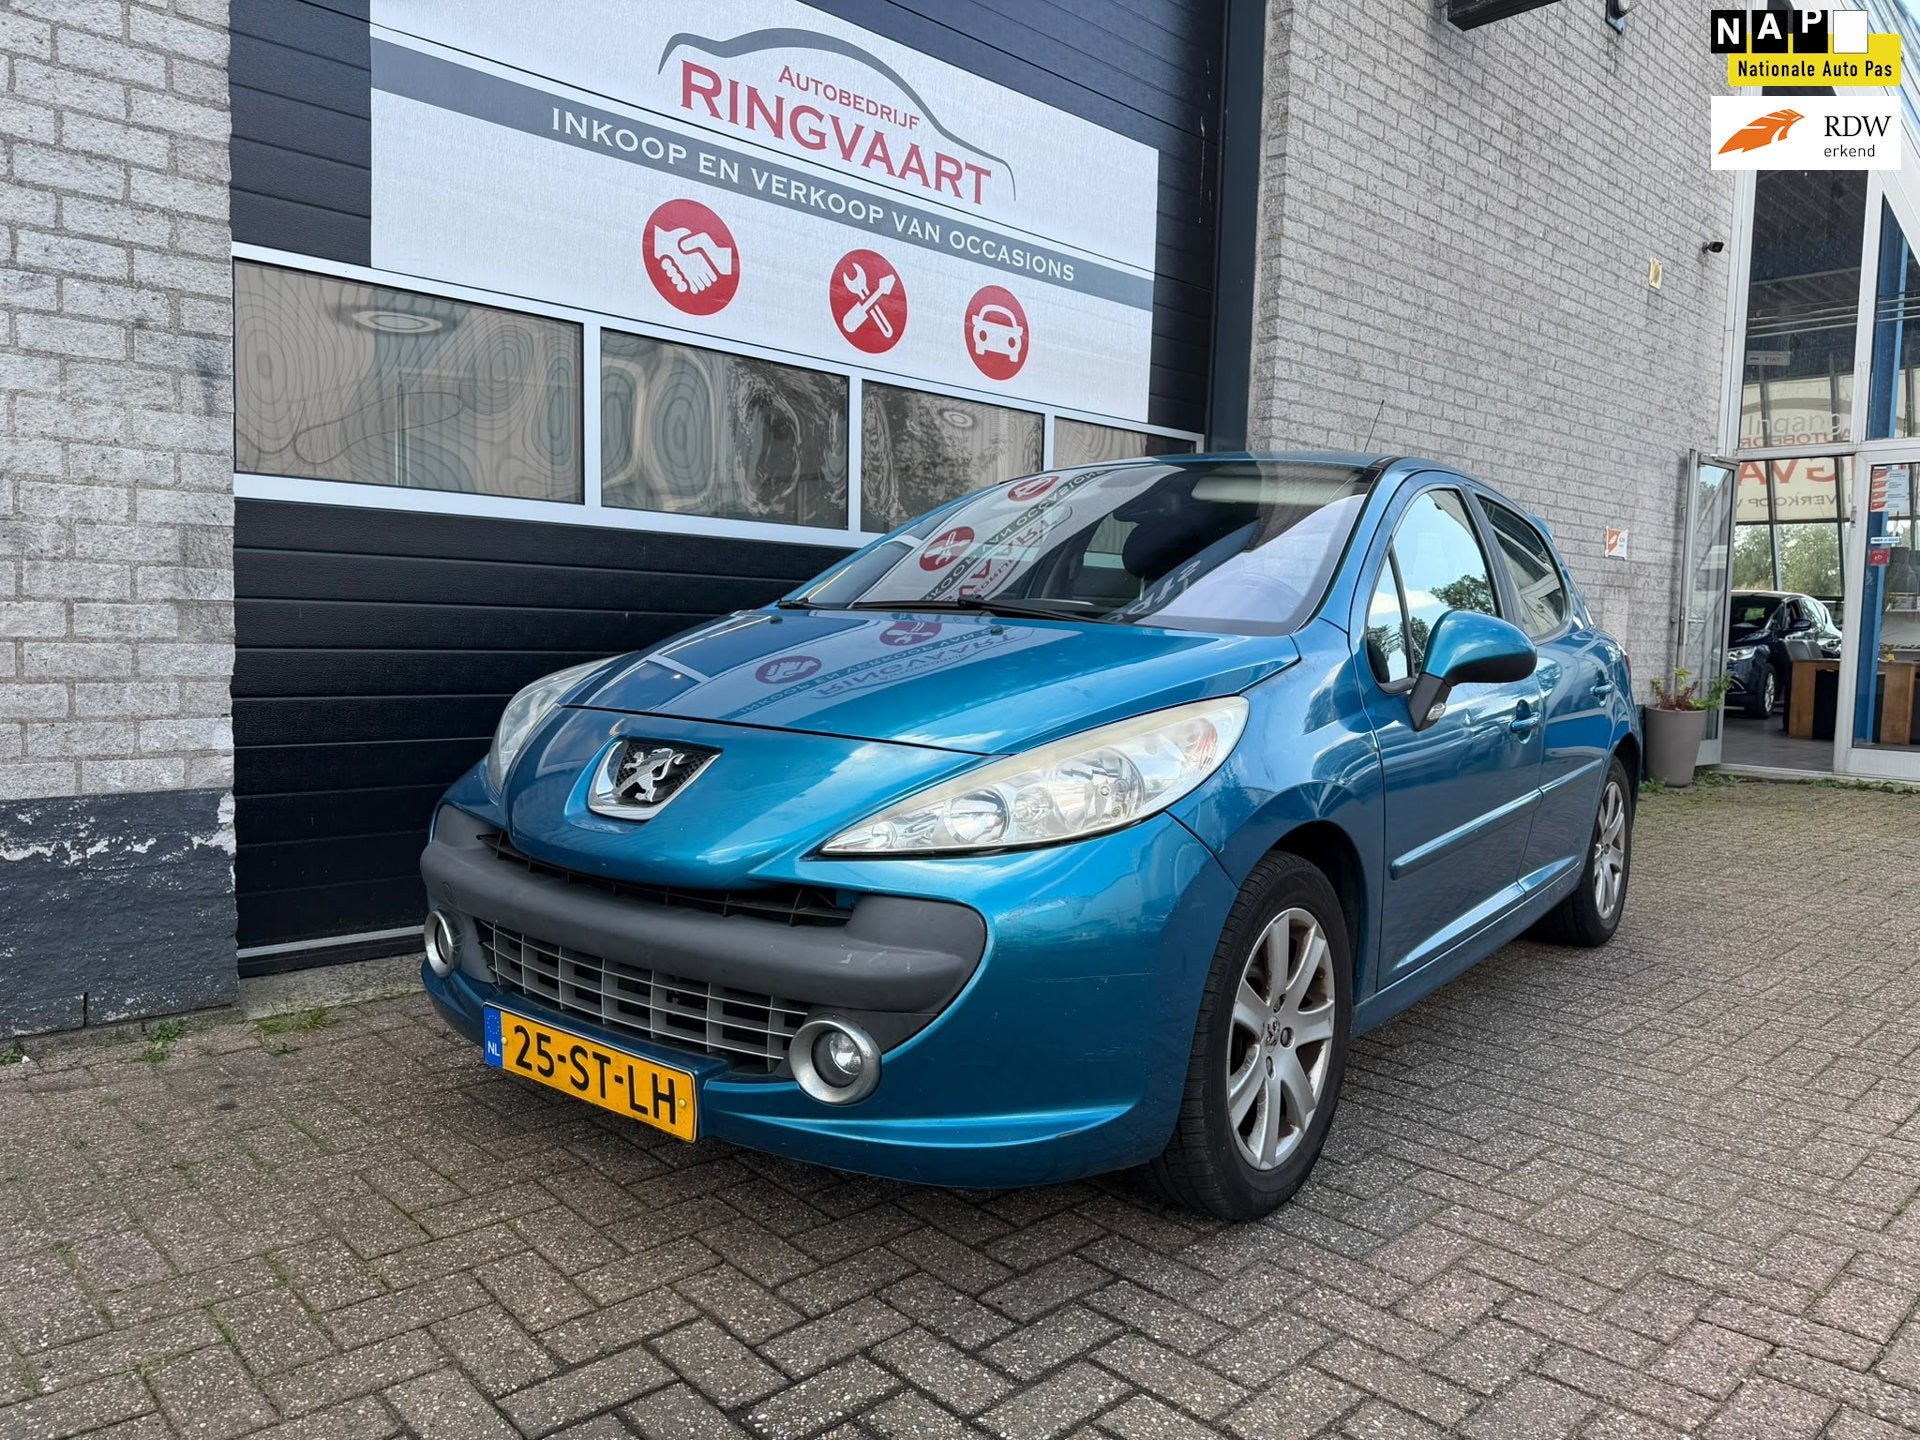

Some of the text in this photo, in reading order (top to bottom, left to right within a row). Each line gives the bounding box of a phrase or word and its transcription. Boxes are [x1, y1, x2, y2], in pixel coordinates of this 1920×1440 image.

[680, 60, 992, 206] RINGVAART
[778, 64, 920, 131] AUTOBEDRIJF
[552, 107, 1075, 283] INKOOP EN VERKOOP VAN OCCASIONS
[487, 1041, 500, 1057] NL
[514, 1025, 676, 1125] 25-ST-LH
